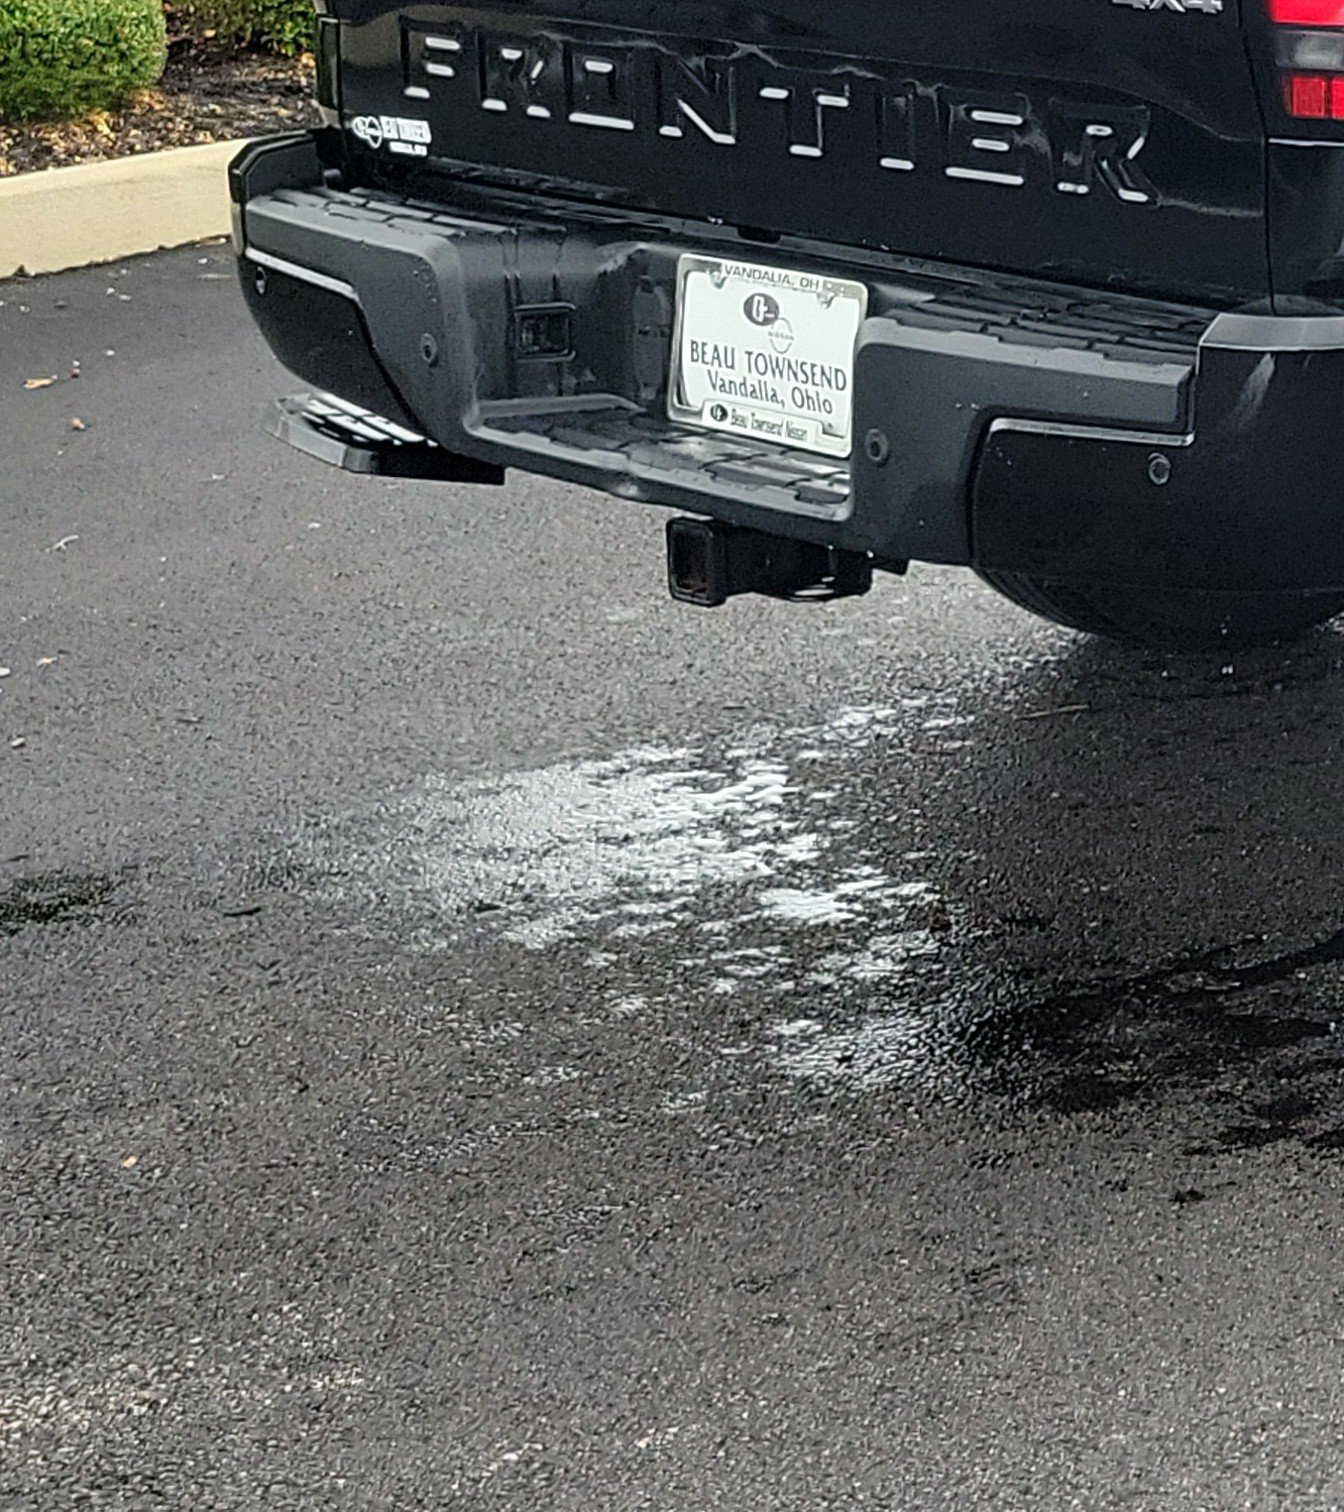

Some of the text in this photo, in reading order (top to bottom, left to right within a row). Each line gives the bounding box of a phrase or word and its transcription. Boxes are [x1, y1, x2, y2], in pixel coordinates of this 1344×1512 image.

[402, 16, 1160, 204] FRONTIER
[724, 264, 794, 287] VANDALIA,
[690, 339, 847, 391] BEAU TOWNSEND
